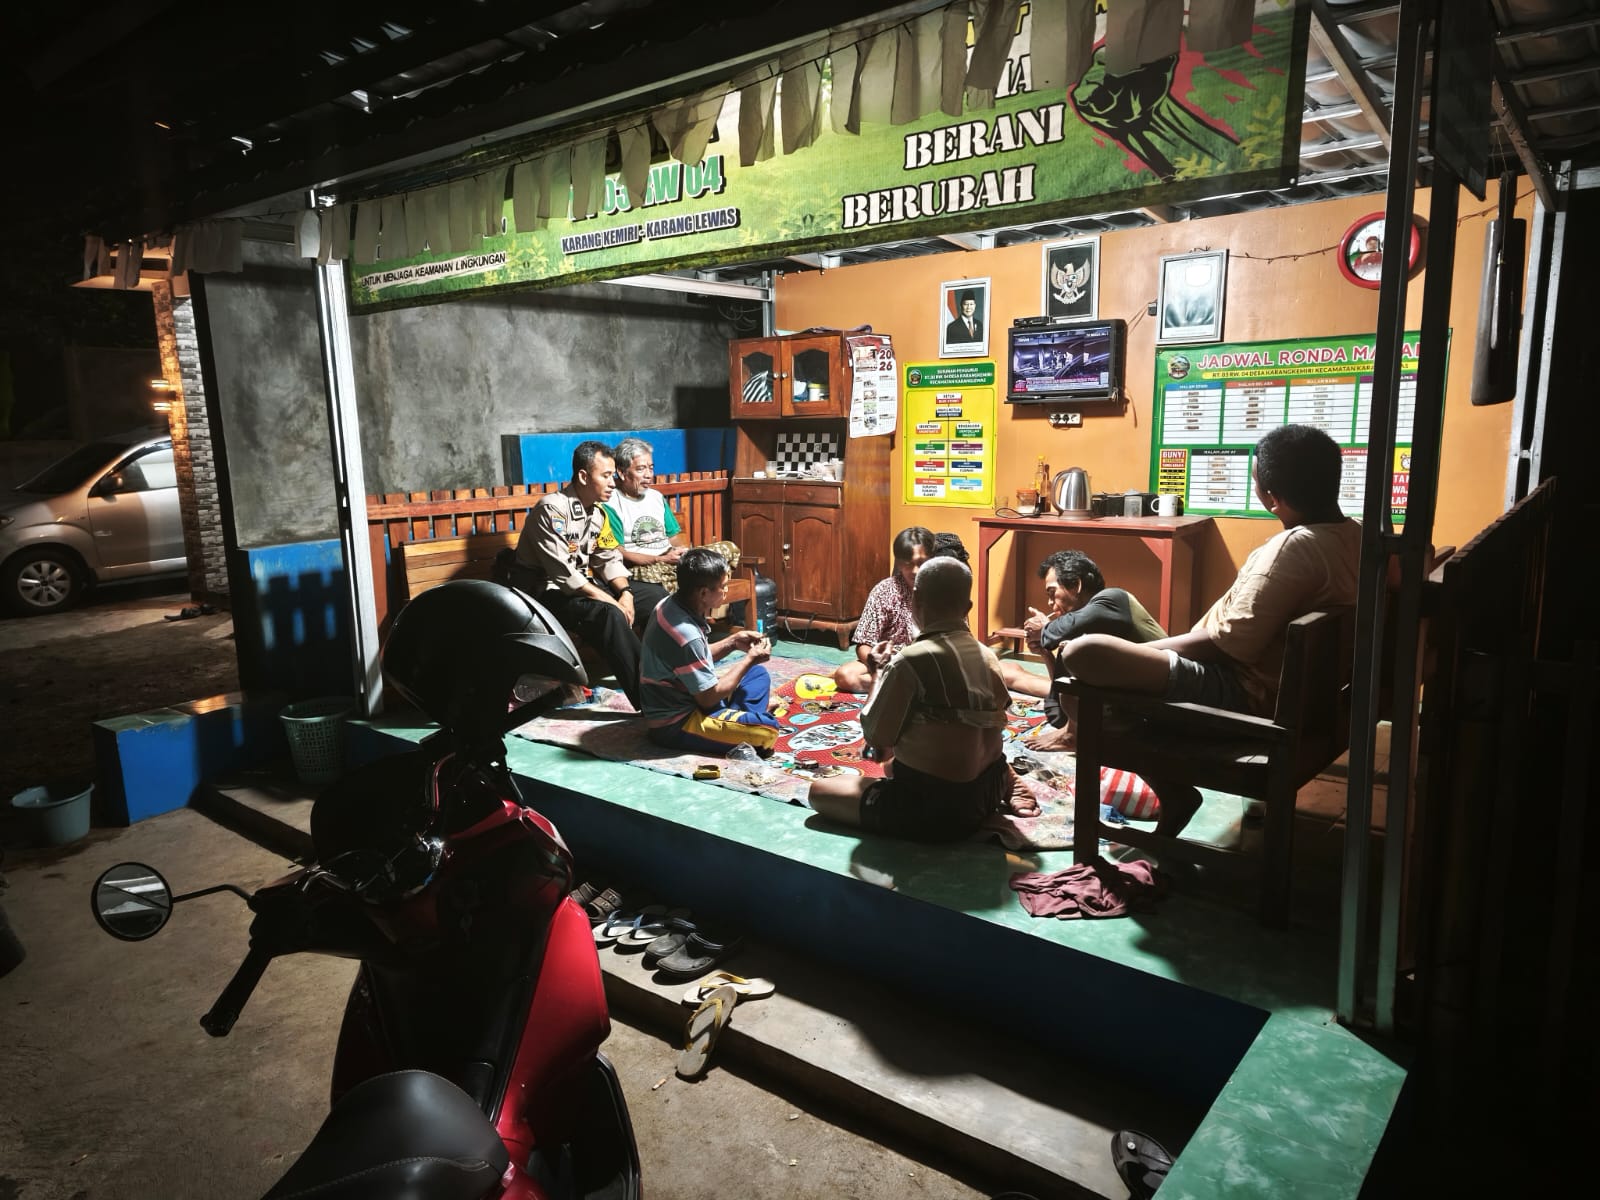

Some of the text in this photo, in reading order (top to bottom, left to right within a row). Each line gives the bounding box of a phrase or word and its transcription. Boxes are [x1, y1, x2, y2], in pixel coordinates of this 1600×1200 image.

[903, 102, 1066, 171] BERANI
[684, 155, 723, 198] 04
[842, 165, 1036, 230] BERUBAH
[561, 232, 602, 253] KARANG
[603, 225, 639, 246] KEMIRI
[646, 216, 693, 239] KARANG
[695, 208, 737, 230] LEWAS
[361, 252, 506, 287] UNTUK MENJAGA KEAMANAN LINGKUNGAN
[879, 349, 893, 360] 20
[879, 362, 893, 371] 26
[1198, 351, 1274, 369] JADWAL
[1279, 347, 1346, 366] RONDA
[1315, 365, 1356, 373] KECAMATAN
[1391, 496, 1408, 505] LAP
